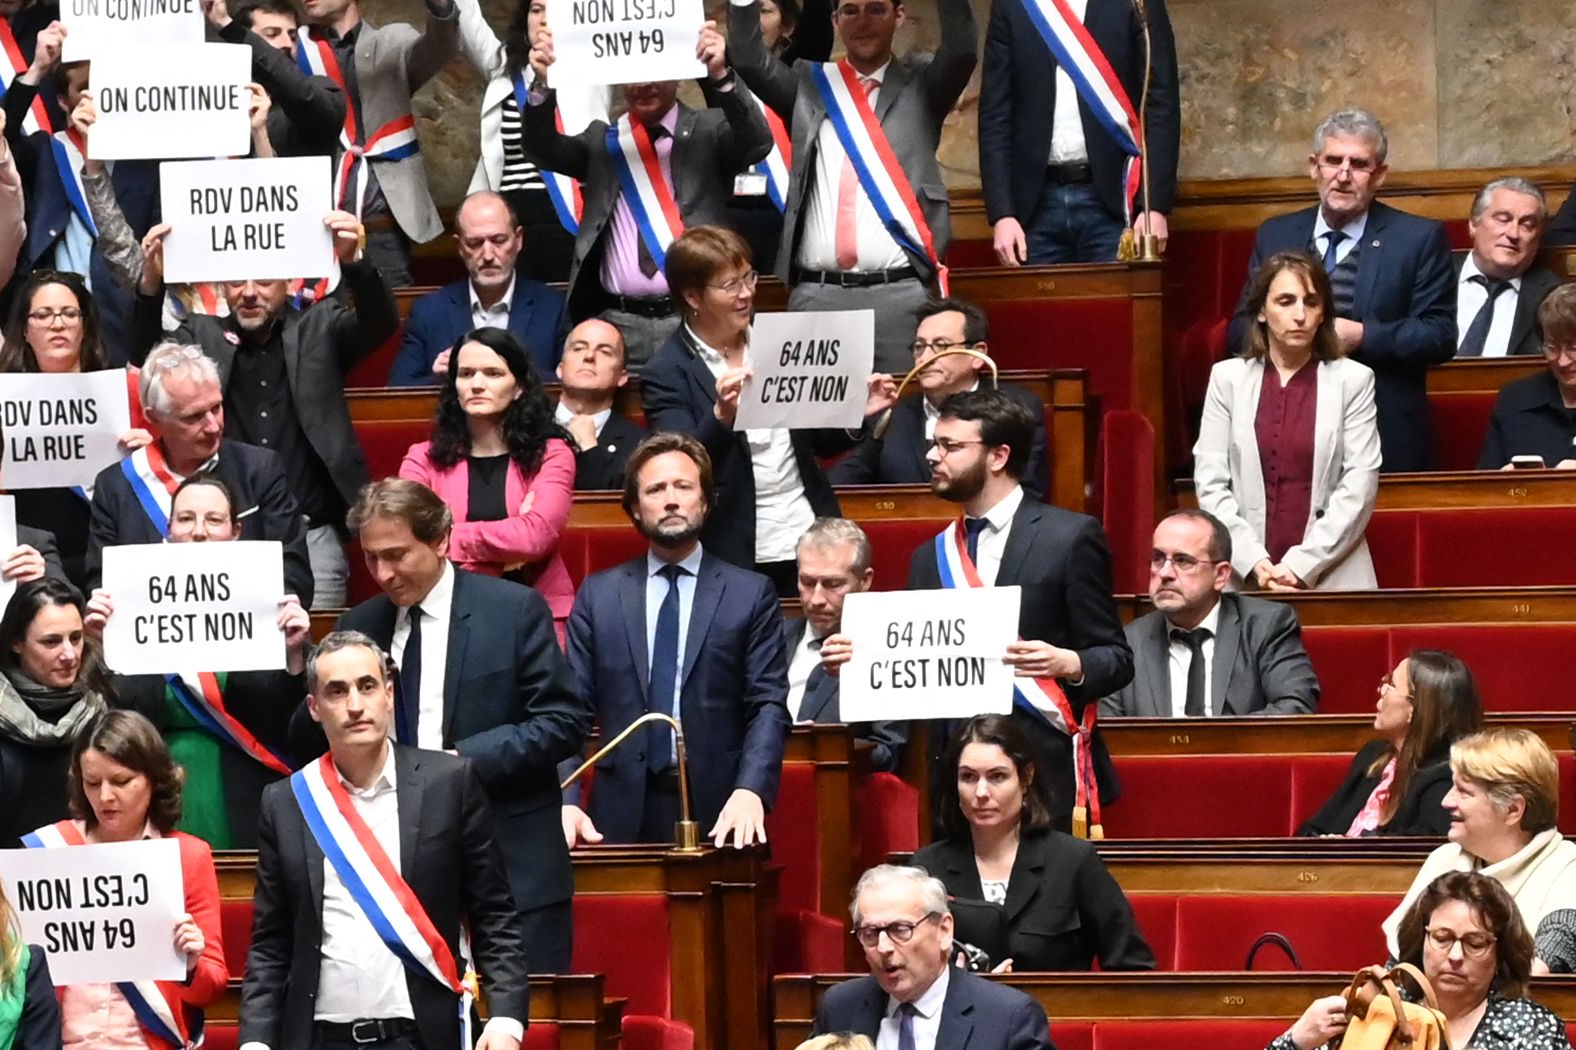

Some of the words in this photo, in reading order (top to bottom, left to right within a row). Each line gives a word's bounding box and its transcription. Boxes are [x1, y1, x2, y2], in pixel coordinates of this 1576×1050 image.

[574, 0, 614, 24] NON
[593, 31, 632, 57] ANS
[639, 29, 664, 53] 64
[101, 88, 127, 113] ON
[136, 85, 238, 112] CONTINUE
[190, 188, 232, 214] RDV
[241, 185, 298, 213] DANS
[212, 225, 237, 251] LA
[244, 223, 285, 250] RUE
[780, 341, 802, 367] 64
[803, 340, 840, 366] ANS
[761, 376, 808, 403] C'EST
[809, 376, 848, 402] NON
[39, 399, 97, 425] DANS
[12, 437, 37, 462] LA
[44, 435, 85, 460] RUE
[149, 576, 177, 603] 64
[185, 573, 230, 602] ANS
[135, 614, 197, 644] C'EST
[205, 612, 252, 641] NON
[887, 622, 912, 648] 64
[920, 619, 965, 646] ANS
[871, 659, 930, 689] C'EST
[938, 657, 984, 686] NON
[18, 878, 72, 911] NON
[80, 874, 148, 908] C'EST
[45, 921, 95, 953] ANS
[103, 919, 135, 949] 64
